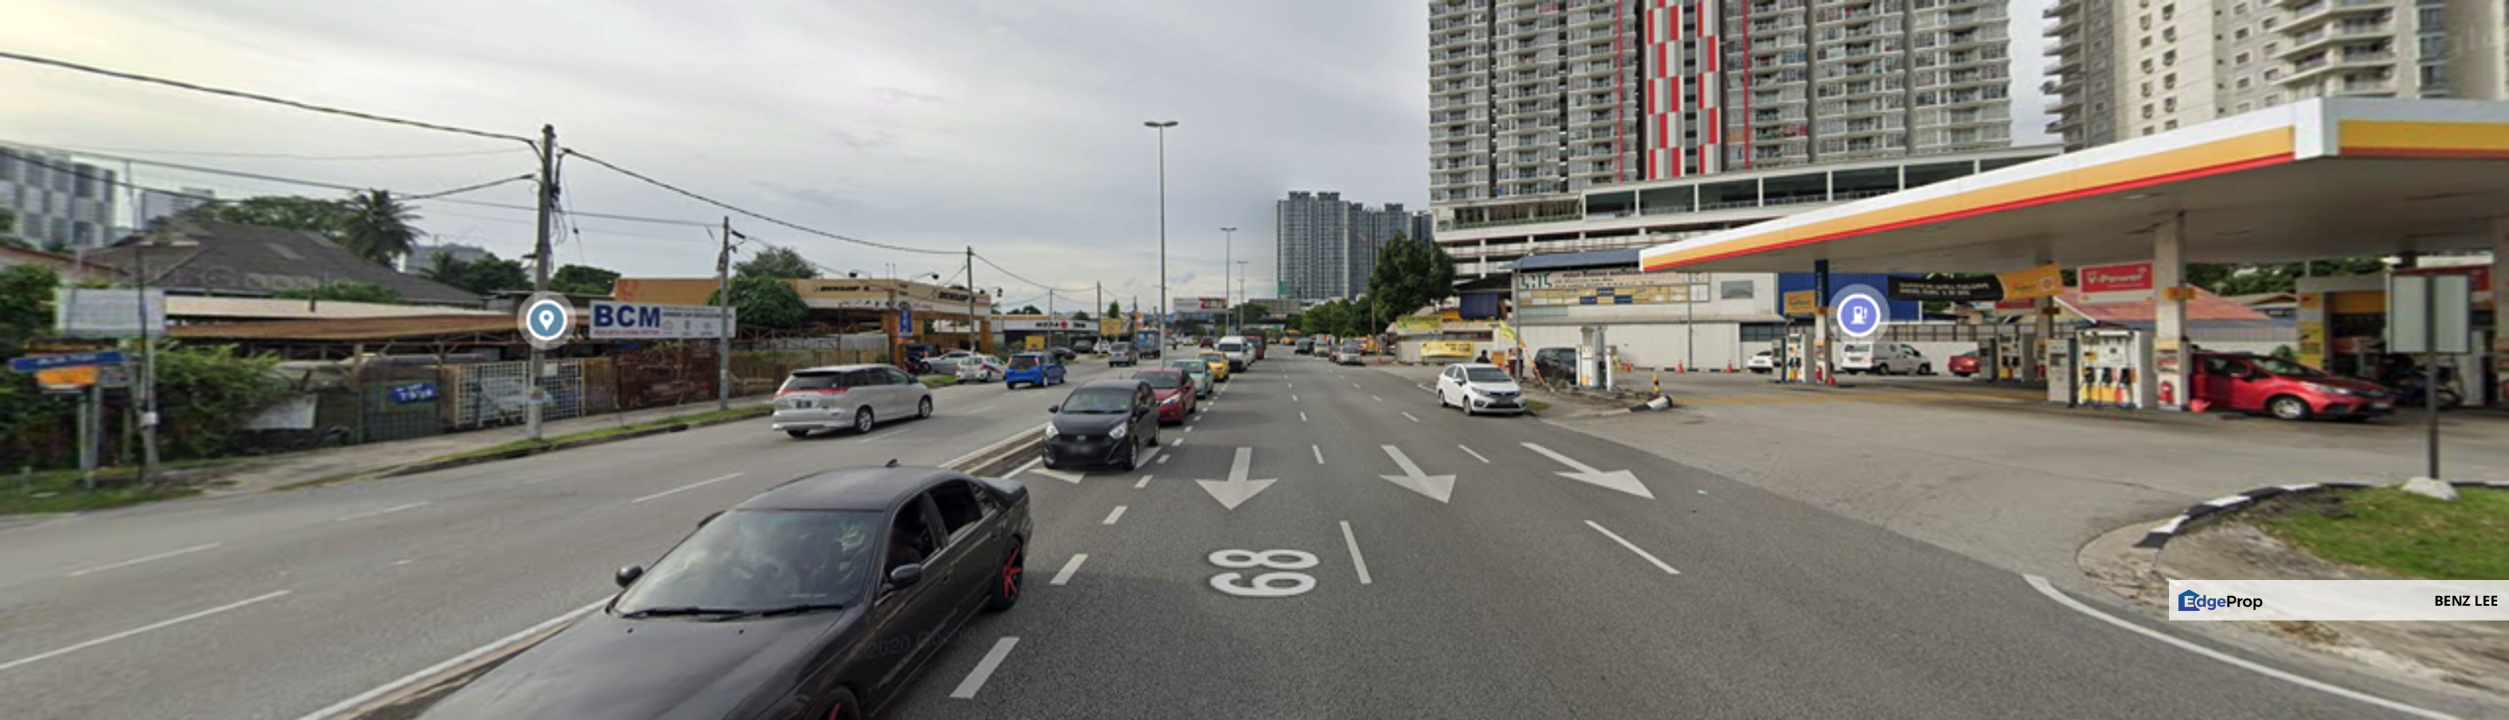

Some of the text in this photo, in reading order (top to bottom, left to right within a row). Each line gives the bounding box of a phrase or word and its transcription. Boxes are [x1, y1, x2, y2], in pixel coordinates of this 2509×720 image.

[1519, 273, 1552, 289] LHL
[2085, 270, 2143, 284] V-Power
[594, 304, 660, 328] BCM
